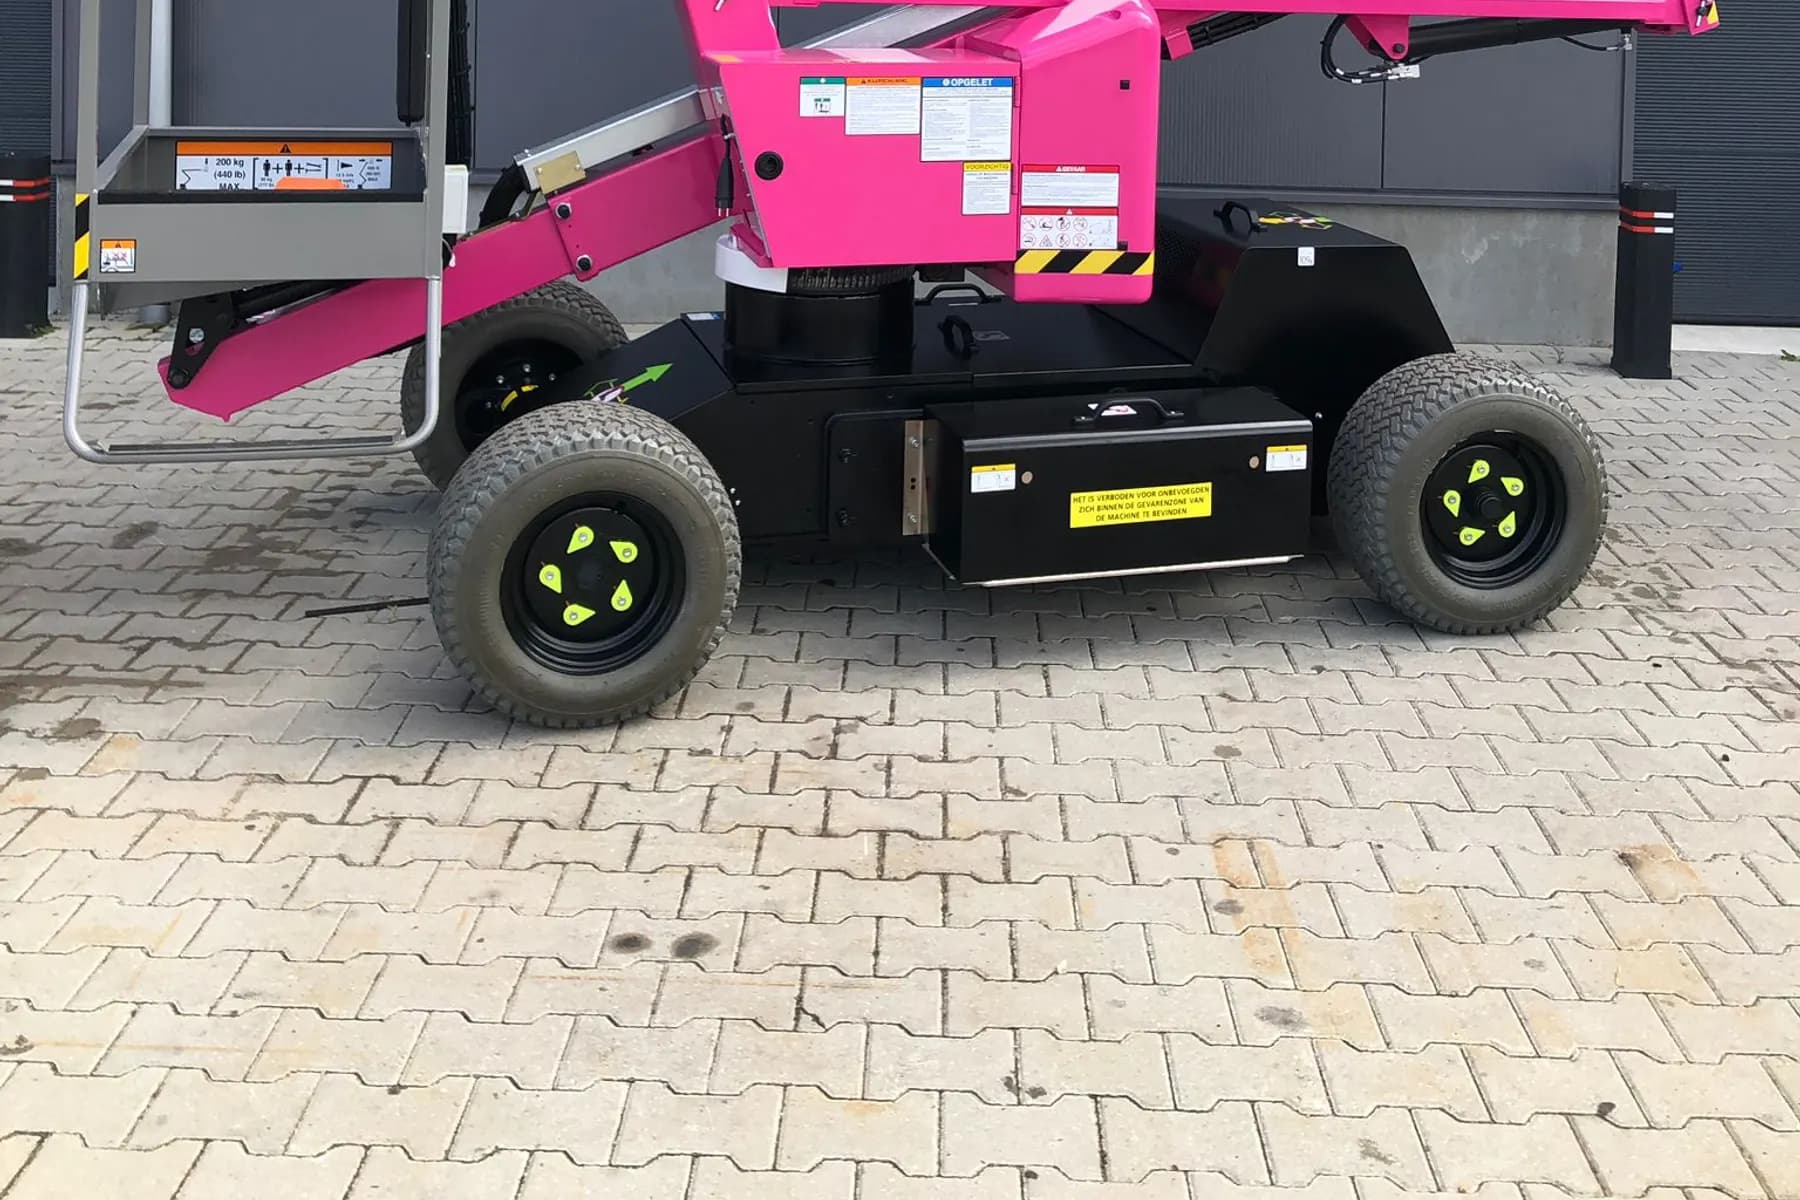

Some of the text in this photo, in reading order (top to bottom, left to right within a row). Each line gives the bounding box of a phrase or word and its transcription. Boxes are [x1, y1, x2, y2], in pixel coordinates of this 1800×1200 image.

[950, 78, 993, 87] OPGELET
[215, 158, 245, 169] 200 kg
[214, 170, 246, 180] (440 lb)
[219, 182, 240, 190] MAX
[1073, 487, 1210, 503] HET IS VERBODEN VOOR ONBEVOEGDEN
[1078, 496, 1204, 514] ZICH BINNEN DE GEVARENZONE VAN
[1096, 508, 1188, 522] DE MACHINE TE BEVINDEN
